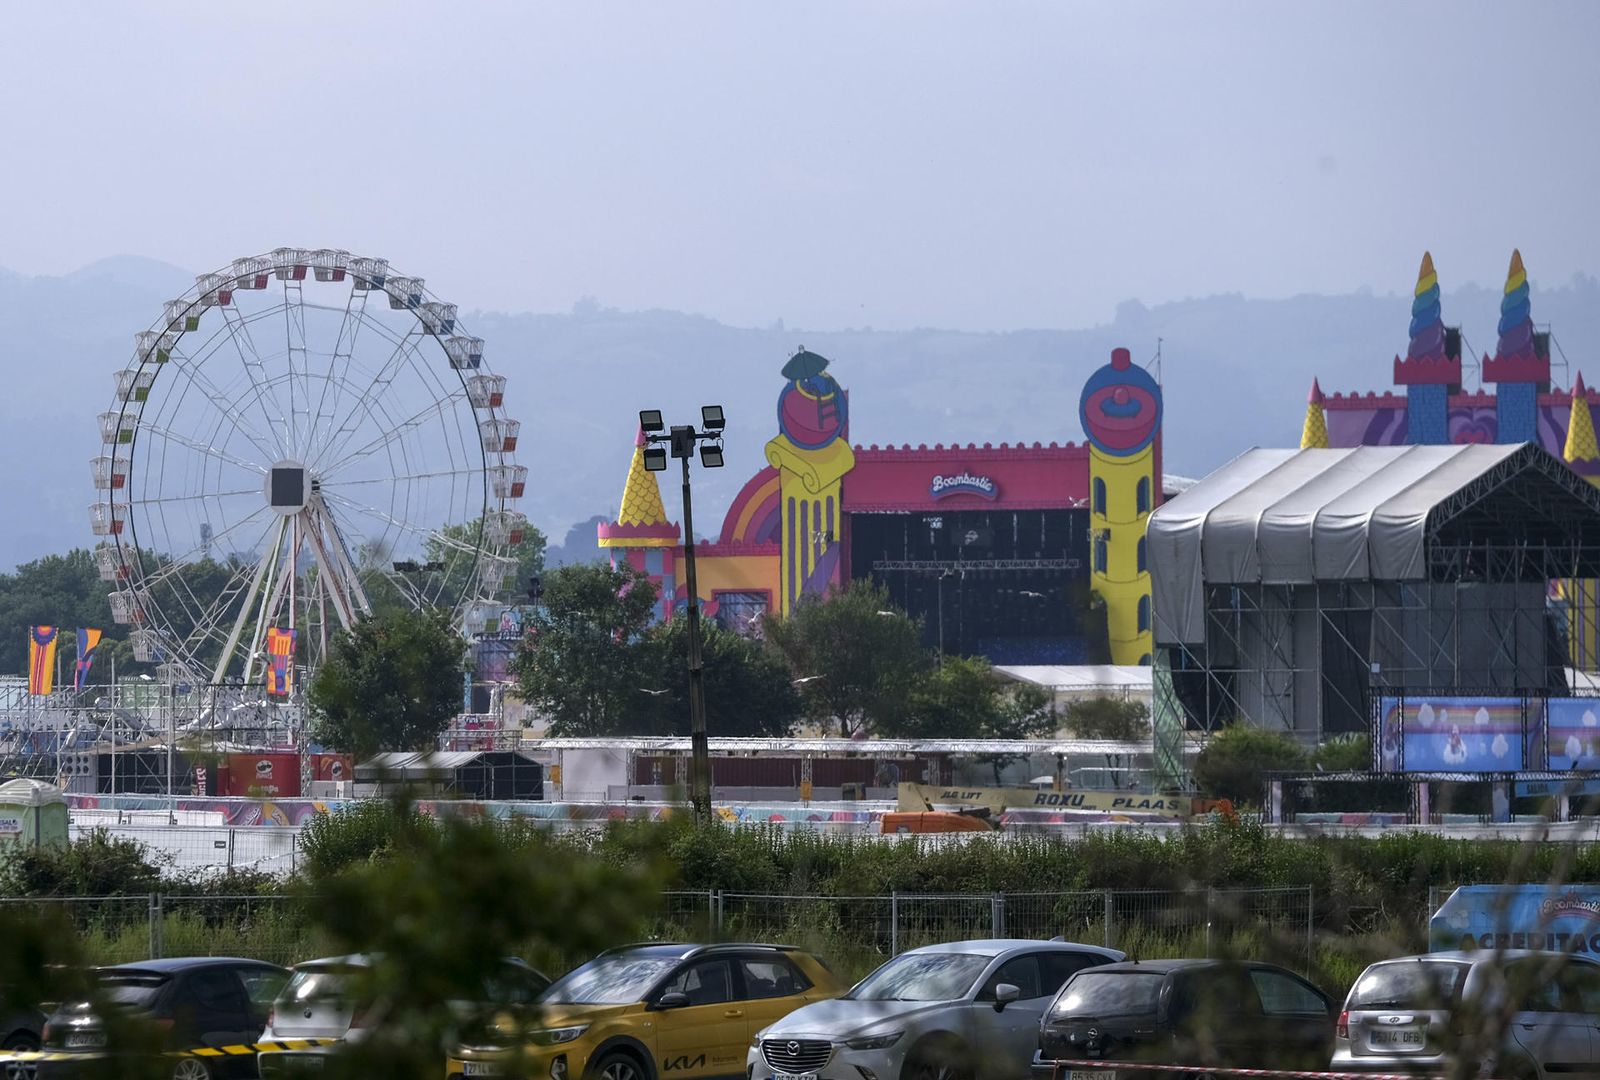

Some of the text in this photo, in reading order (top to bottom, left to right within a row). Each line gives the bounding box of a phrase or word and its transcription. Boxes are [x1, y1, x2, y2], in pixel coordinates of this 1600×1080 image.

[932, 472, 993, 491] Boombastic
[940, 791, 959, 799] JLG
[1034, 793, 1085, 806] ROXU
[1544, 899, 1600, 914] Boombasti
